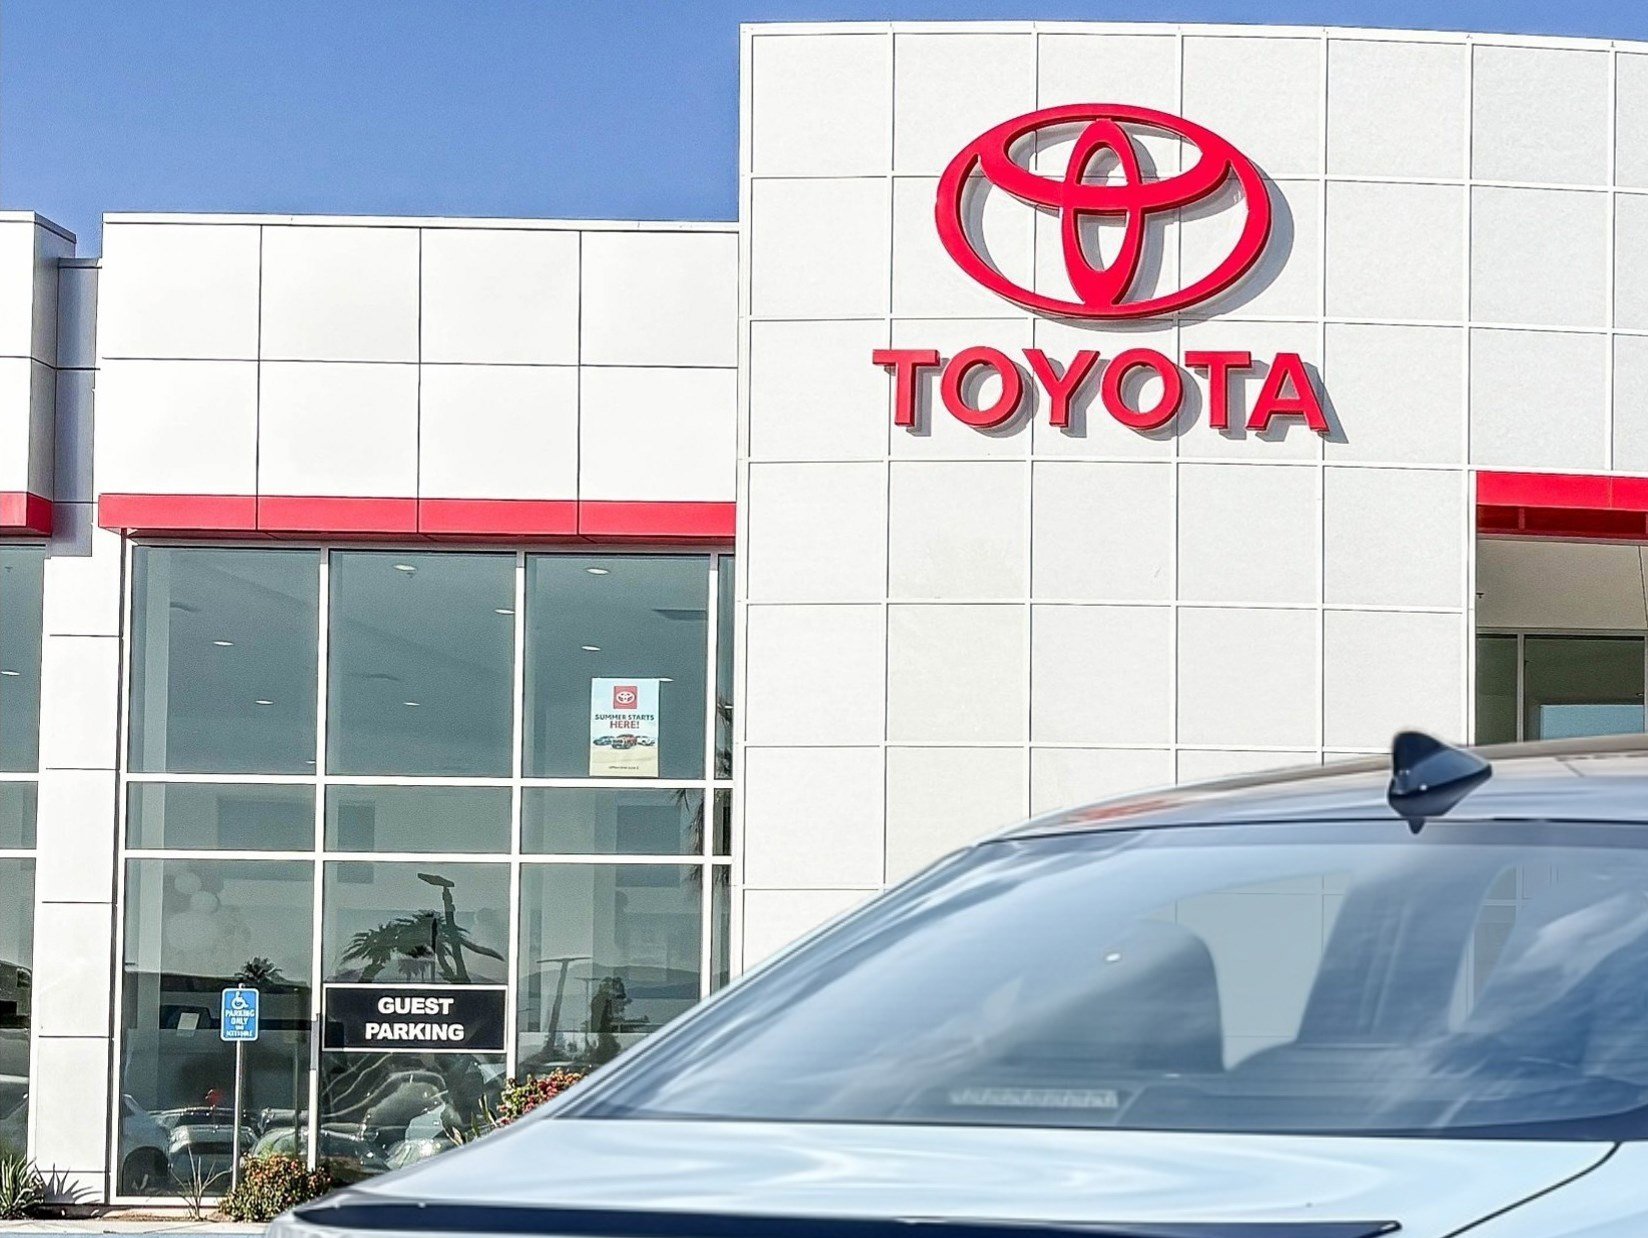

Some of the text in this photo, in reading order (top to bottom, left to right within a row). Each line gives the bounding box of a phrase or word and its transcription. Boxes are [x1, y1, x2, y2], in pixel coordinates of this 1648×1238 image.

[872, 346, 1329, 432] TOYOTA
[609, 720, 640, 729] HERE!
[377, 997, 454, 1015] GUEST
[364, 1022, 465, 1041] PARKING
